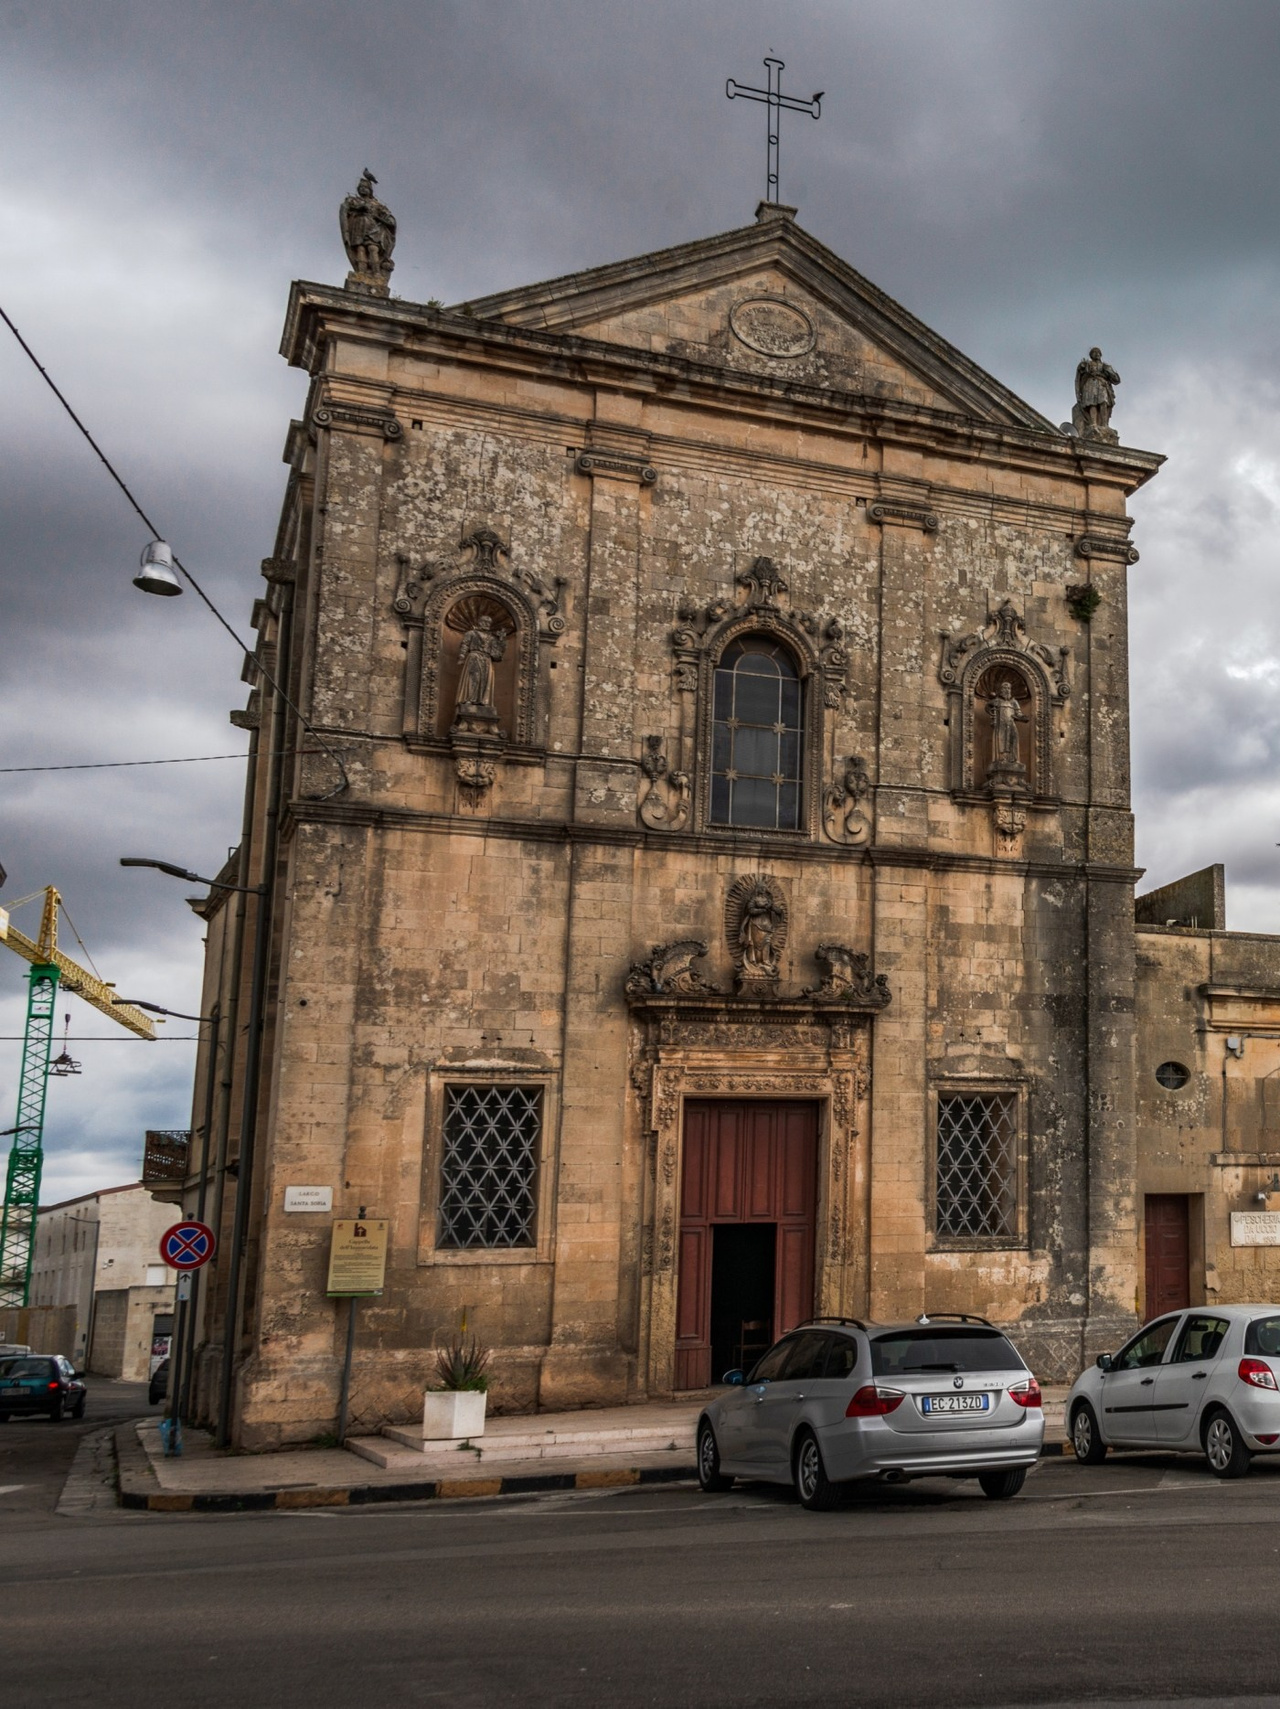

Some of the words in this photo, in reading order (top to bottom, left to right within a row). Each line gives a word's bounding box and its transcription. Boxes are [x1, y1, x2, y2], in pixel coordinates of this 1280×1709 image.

[1240, 1214, 1280, 1224] PESCHERIA
[931, 1398, 945, 1411] EC
[948, 1395, 982, 1409] 213ZD
